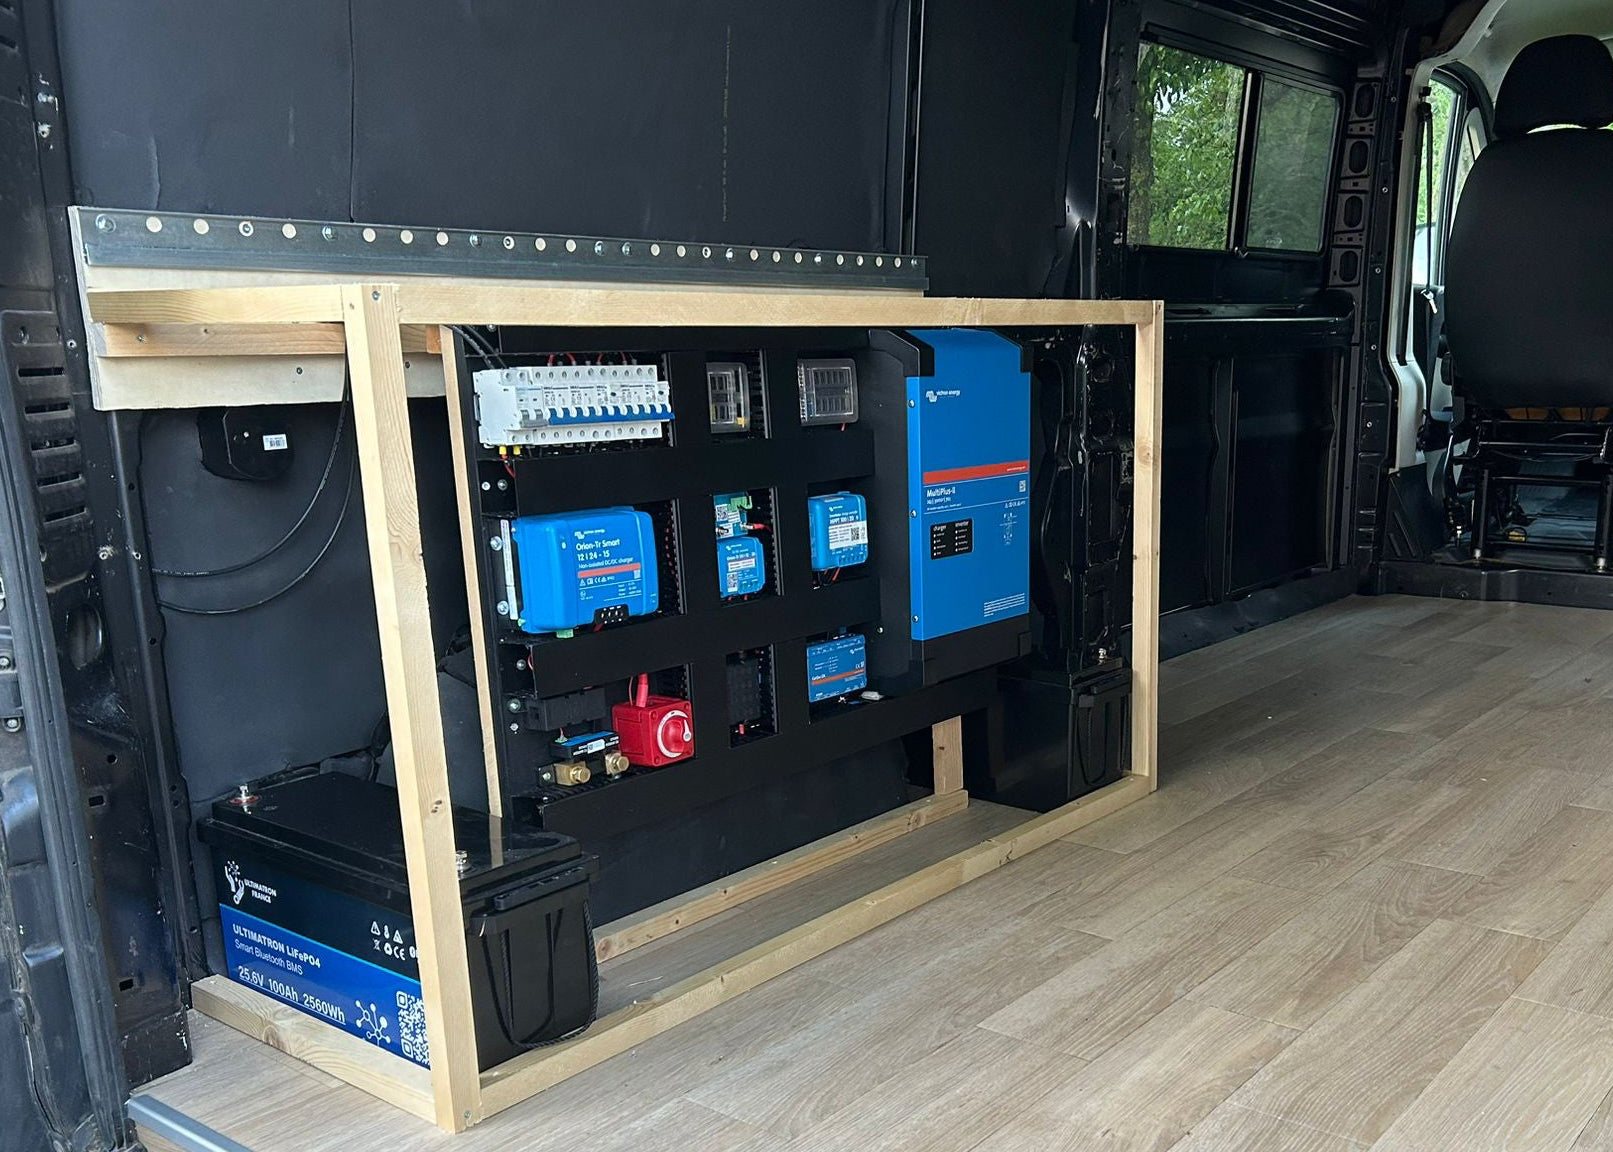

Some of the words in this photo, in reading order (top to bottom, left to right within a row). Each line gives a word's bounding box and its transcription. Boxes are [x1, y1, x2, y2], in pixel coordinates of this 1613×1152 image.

[576, 541, 601, 550] Orion-Tr
[602, 539, 620, 548] Smart
[244, 878, 277, 897] ULTIMATRON
[251, 890, 271, 904] FRANCE
[232, 923, 286, 954] ULTIMATRON
[286, 944, 321, 968] LiFePO4
[234, 939, 255, 956] Smart
[254, 947, 286, 969] Bluetooth
[286, 959, 303, 976] BMS
[238, 965, 265, 986] 25.6V
[267, 978, 299, 1002] 100Ah
[302, 993, 346, 1022] 2560Wh
